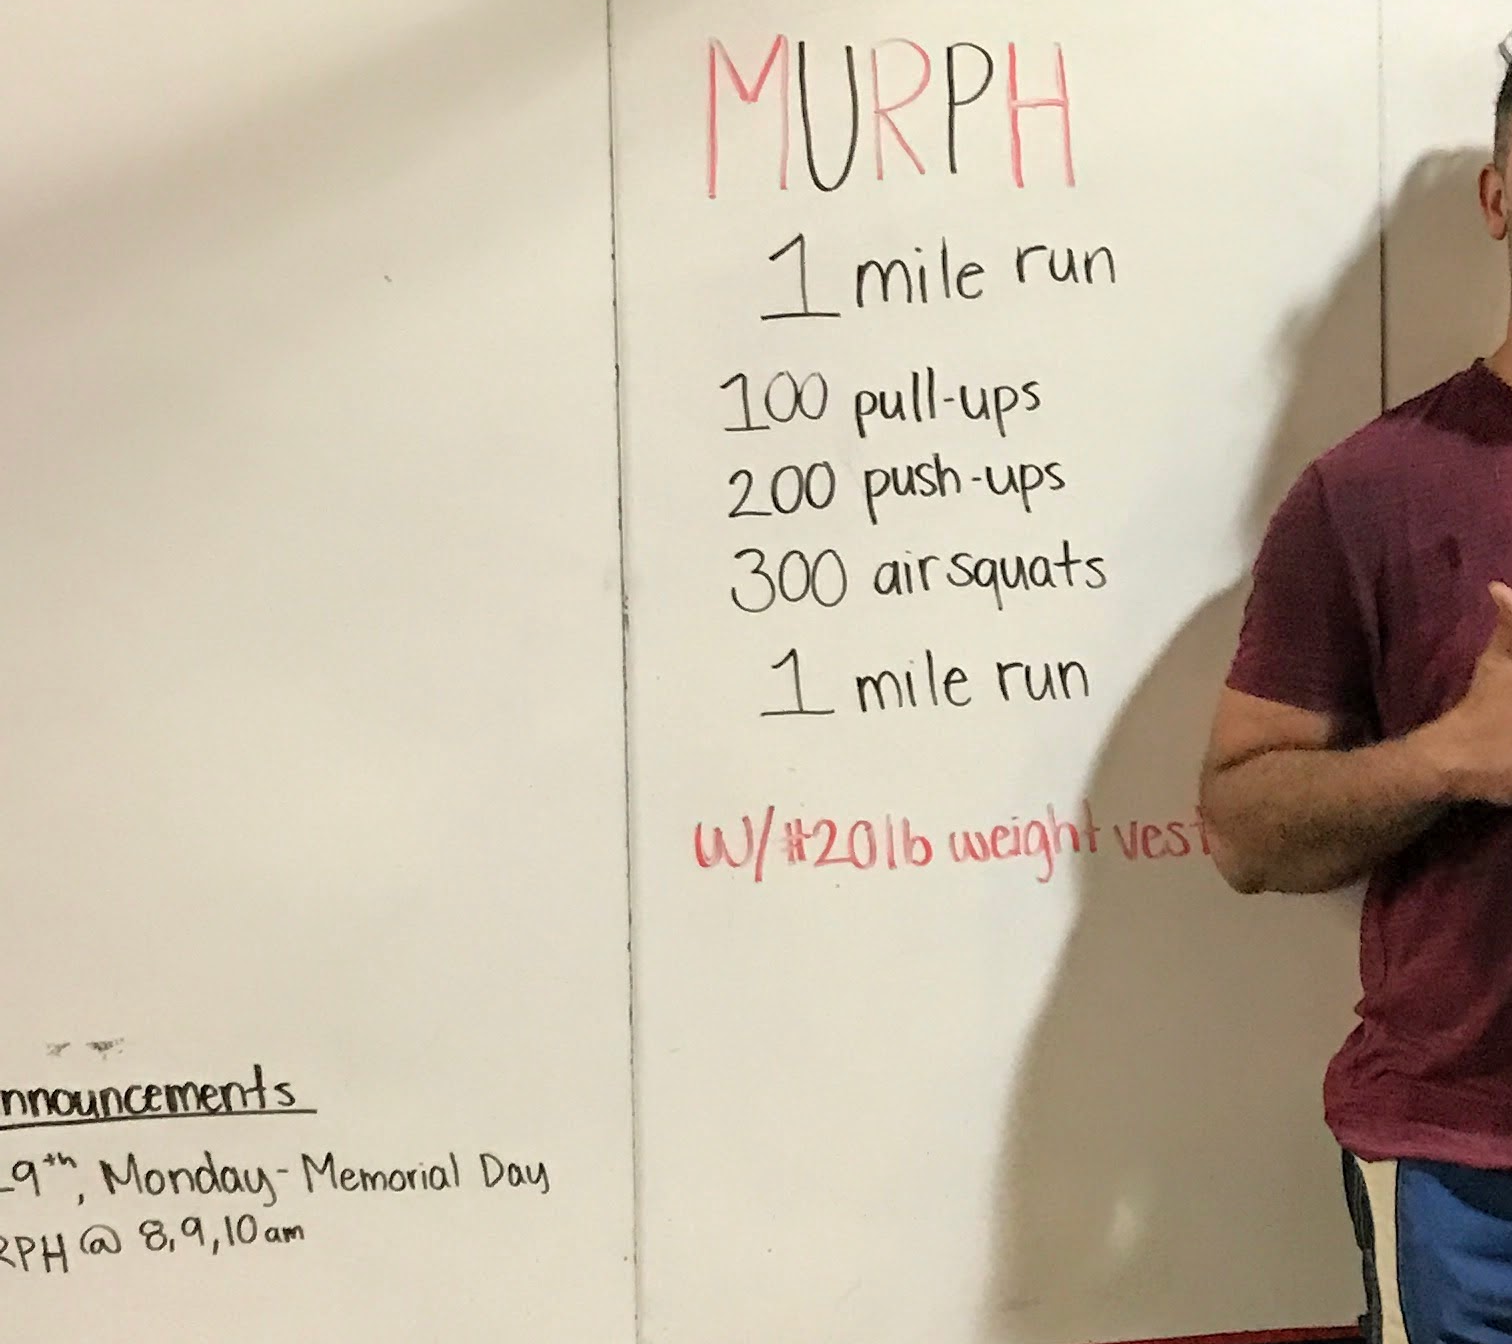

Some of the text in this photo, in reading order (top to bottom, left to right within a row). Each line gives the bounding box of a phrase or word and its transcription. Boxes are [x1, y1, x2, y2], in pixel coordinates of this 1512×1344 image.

[704, 32, 1076, 201] MURPH
[760, 233, 1116, 322] 1 mile run
[719, 366, 1041, 439] 100 pull-ups
[728, 453, 1067, 525] 200 push-ups
[731, 548, 848, 613] 300
[760, 648, 1090, 717] 1 mile run
[948, 798, 1101, 884] weight
[1113, 805, 1211, 859] vest
[301, 1152, 460, 1194] Memorial
[479, 1152, 550, 1195] Day
[80, 1224, 122, 1256] @
